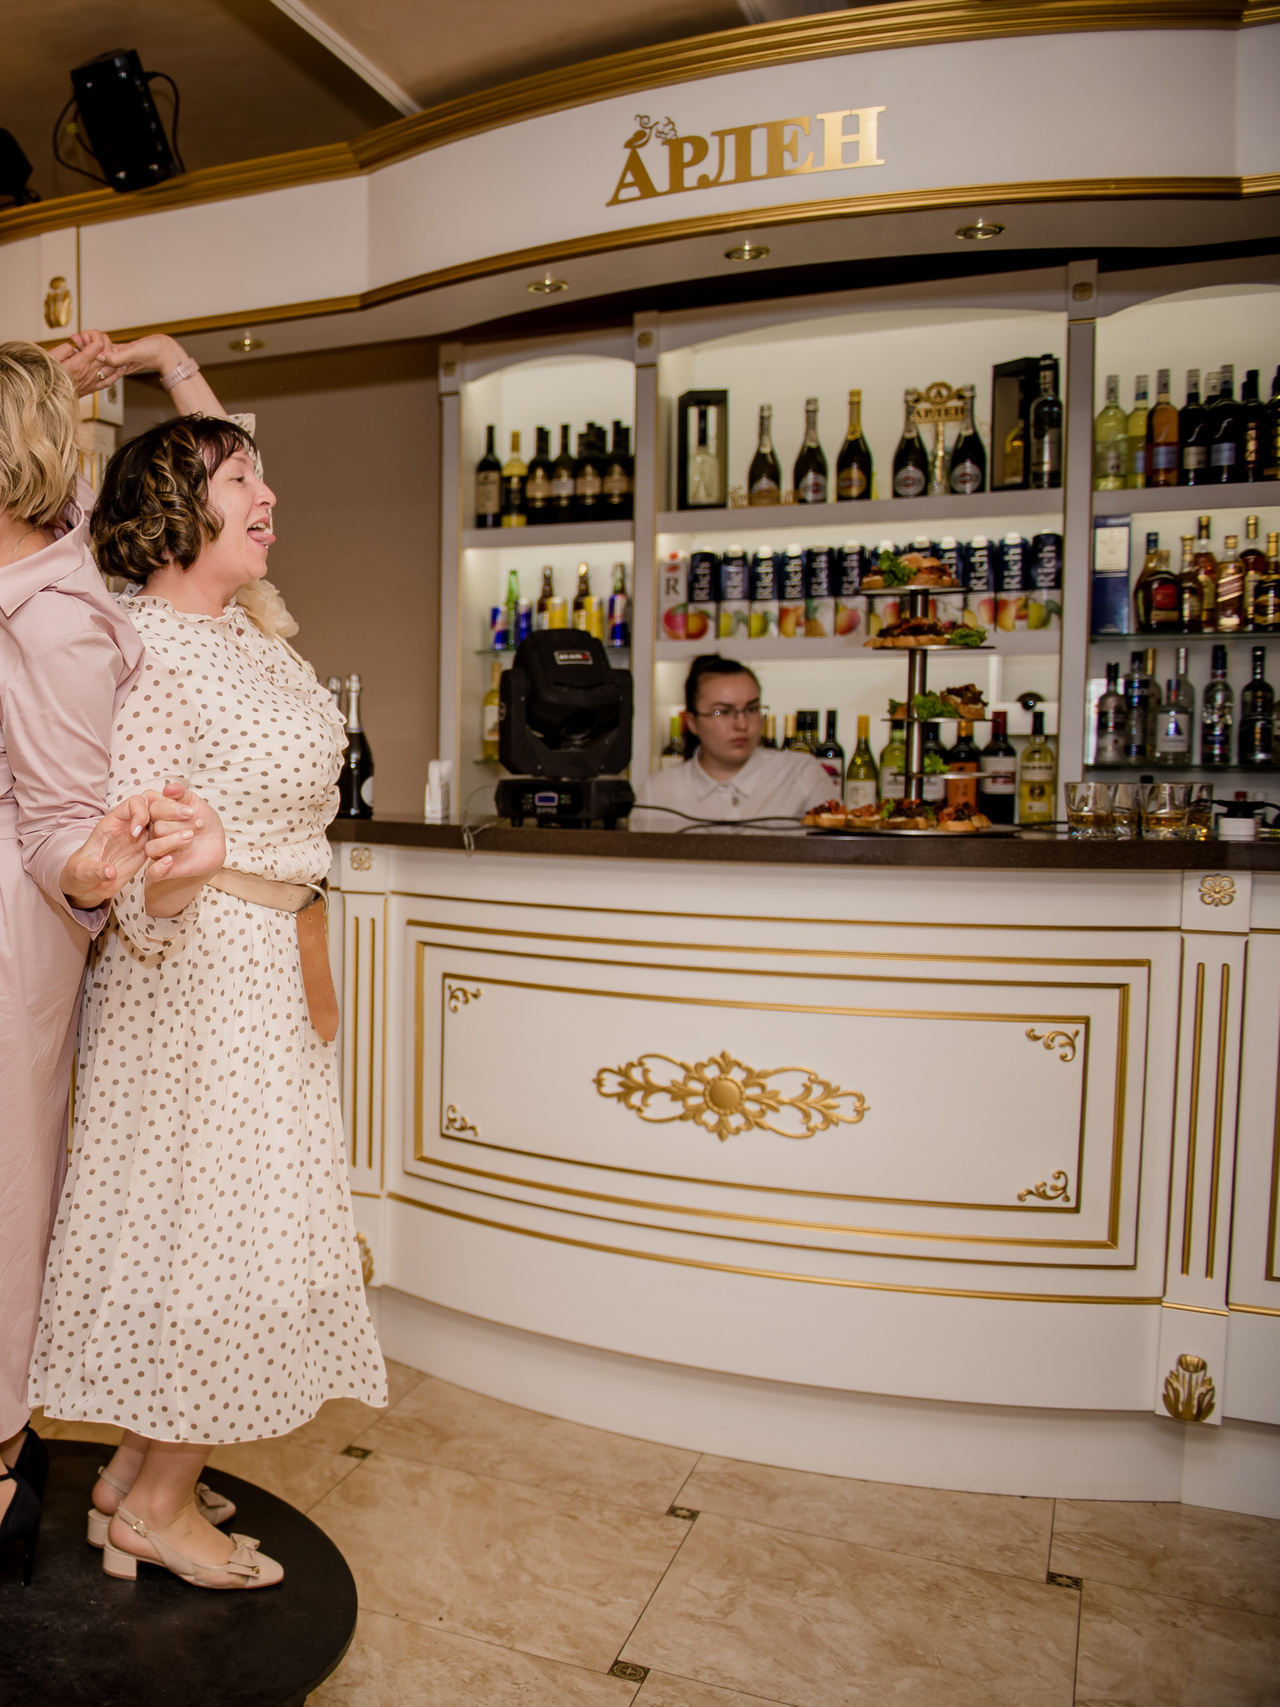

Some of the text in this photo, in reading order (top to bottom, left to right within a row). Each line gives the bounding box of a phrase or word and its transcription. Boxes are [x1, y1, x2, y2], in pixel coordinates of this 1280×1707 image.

[606, 105, 886, 208] АРЛЕН
[665, 577, 679, 595] R
[694, 561, 711, 601] Rich
[726, 558, 744, 600] Rich
[756, 559, 773, 600] Rich
[785, 558, 802, 599] Rich
[811, 554, 828, 596] Rich
[842, 553, 859, 595] Rich
[969, 549, 988, 590] Rich
[1003, 547, 1022, 589] Rich
[1037, 545, 1056, 587] Rich
